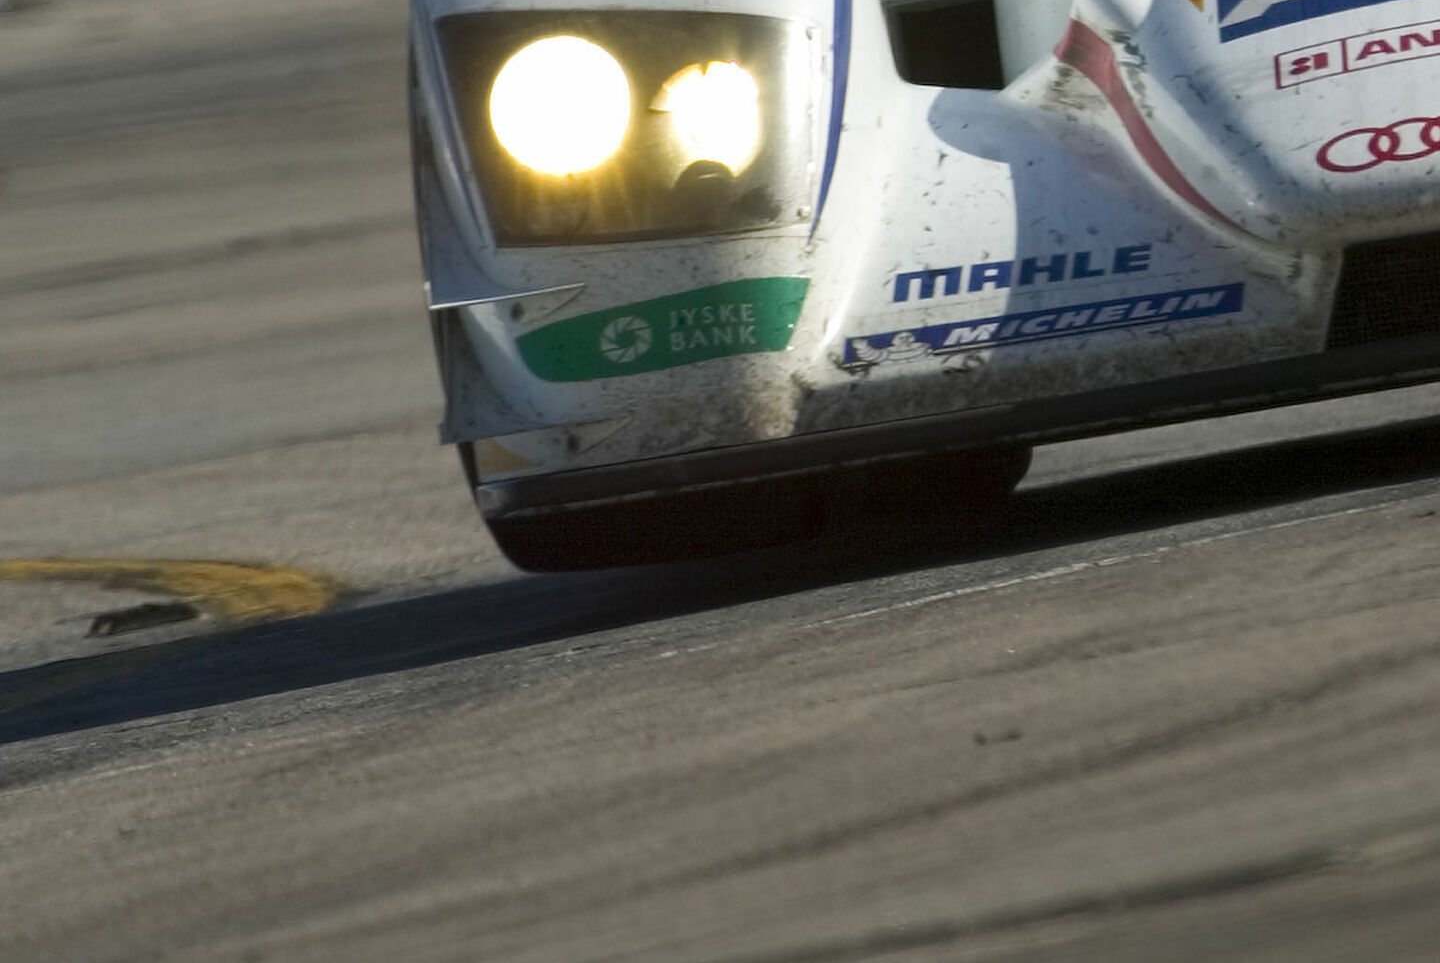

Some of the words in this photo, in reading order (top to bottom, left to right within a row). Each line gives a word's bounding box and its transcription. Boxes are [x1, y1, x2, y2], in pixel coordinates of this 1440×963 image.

[893, 244, 1151, 303] MAHLE
[669, 304, 755, 329] JYSKE
[943, 291, 1225, 346] MICHELIN
[669, 326, 757, 352] BANK
